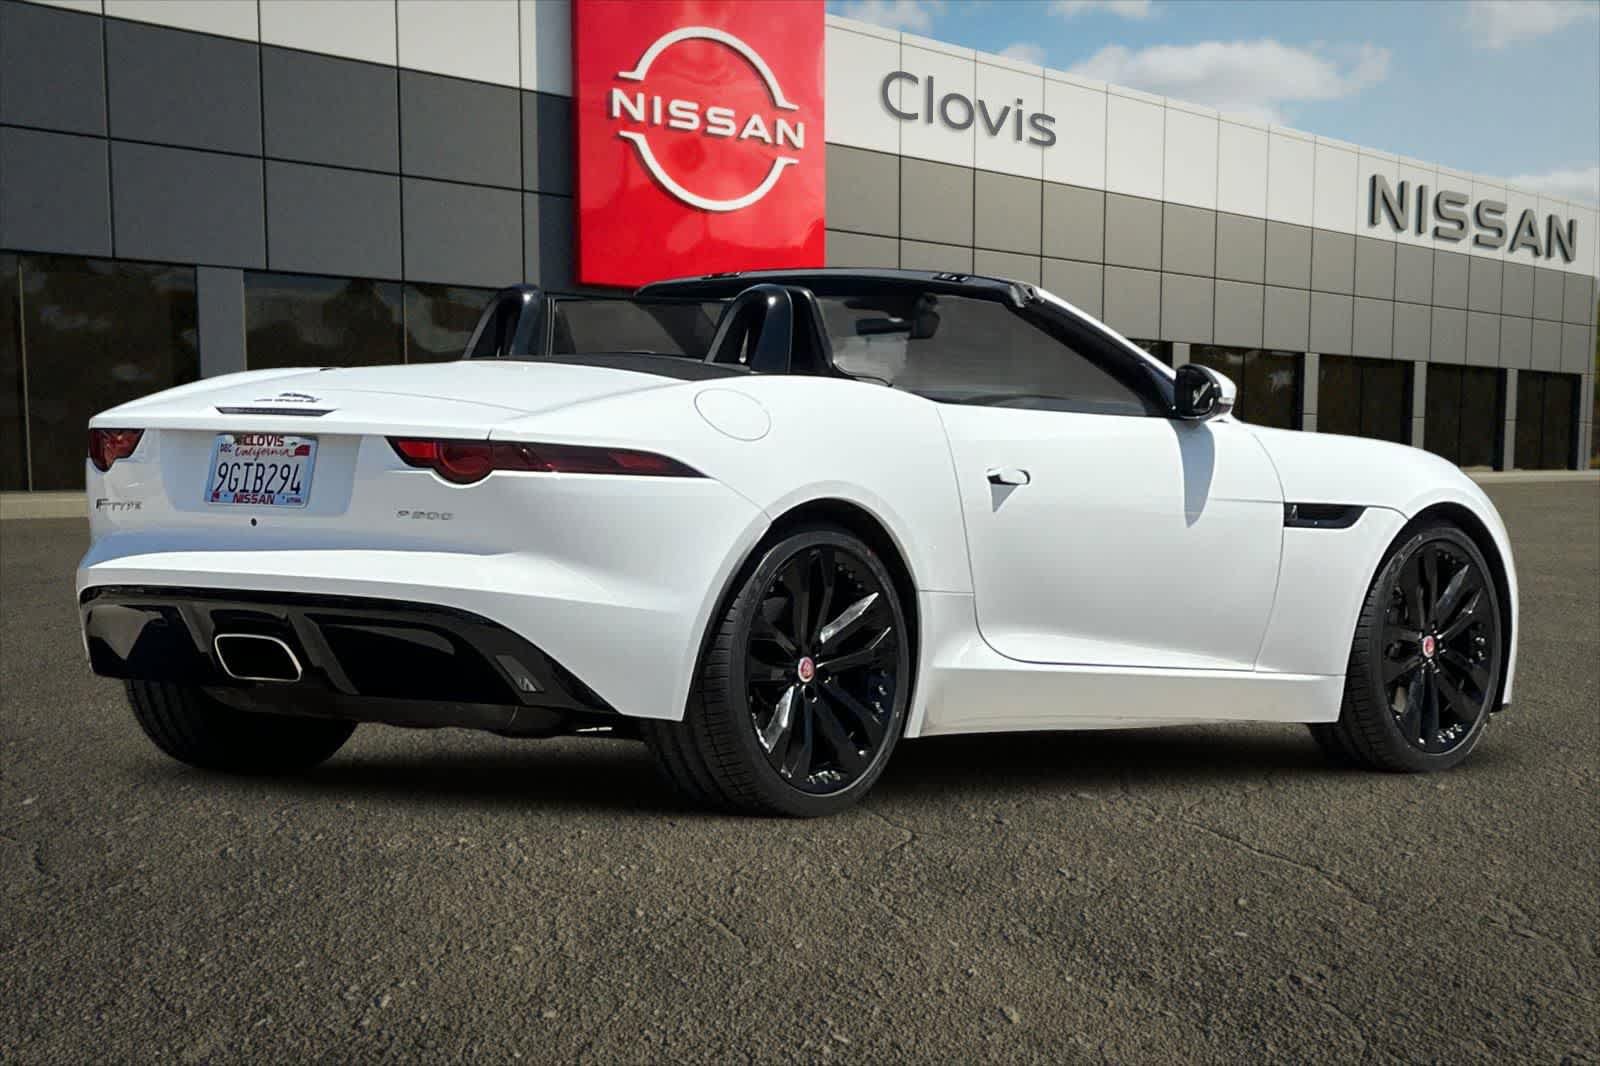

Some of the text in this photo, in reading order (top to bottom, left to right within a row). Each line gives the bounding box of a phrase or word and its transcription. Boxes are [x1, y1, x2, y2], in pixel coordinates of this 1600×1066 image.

[610, 87, 805, 150] NISSAN
[881, 71, 1057, 147] Clovis
[1368, 173, 1578, 263] NISSAN
[235, 446, 297, 459] California
[243, 433, 285, 447] CLOVIS
[215, 462, 301, 495] 9GIB294
[232, 494, 275, 504] NISSAN
